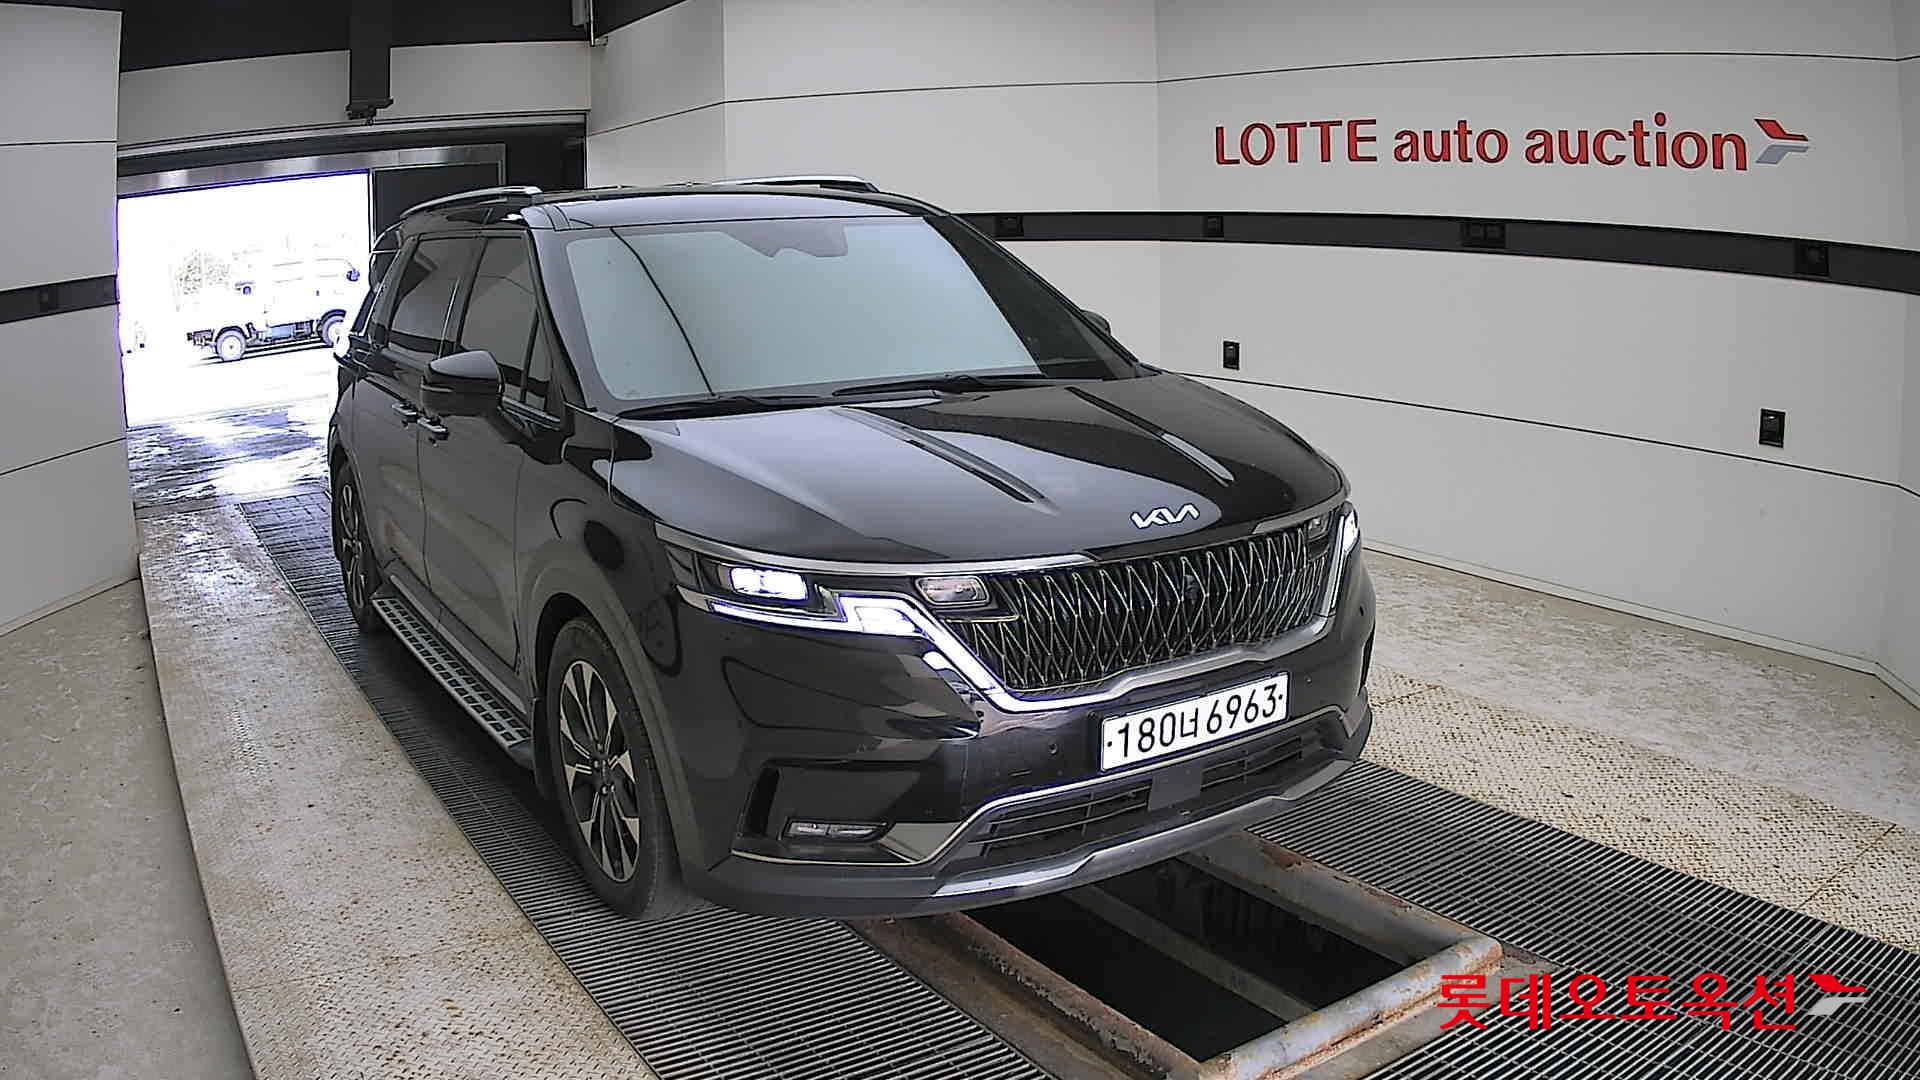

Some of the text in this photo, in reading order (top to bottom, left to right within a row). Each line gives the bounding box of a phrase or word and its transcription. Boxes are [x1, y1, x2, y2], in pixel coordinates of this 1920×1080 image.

[1214, 112, 1749, 172] LOTTE auto auction
[1206, 683, 1277, 735] 6963
